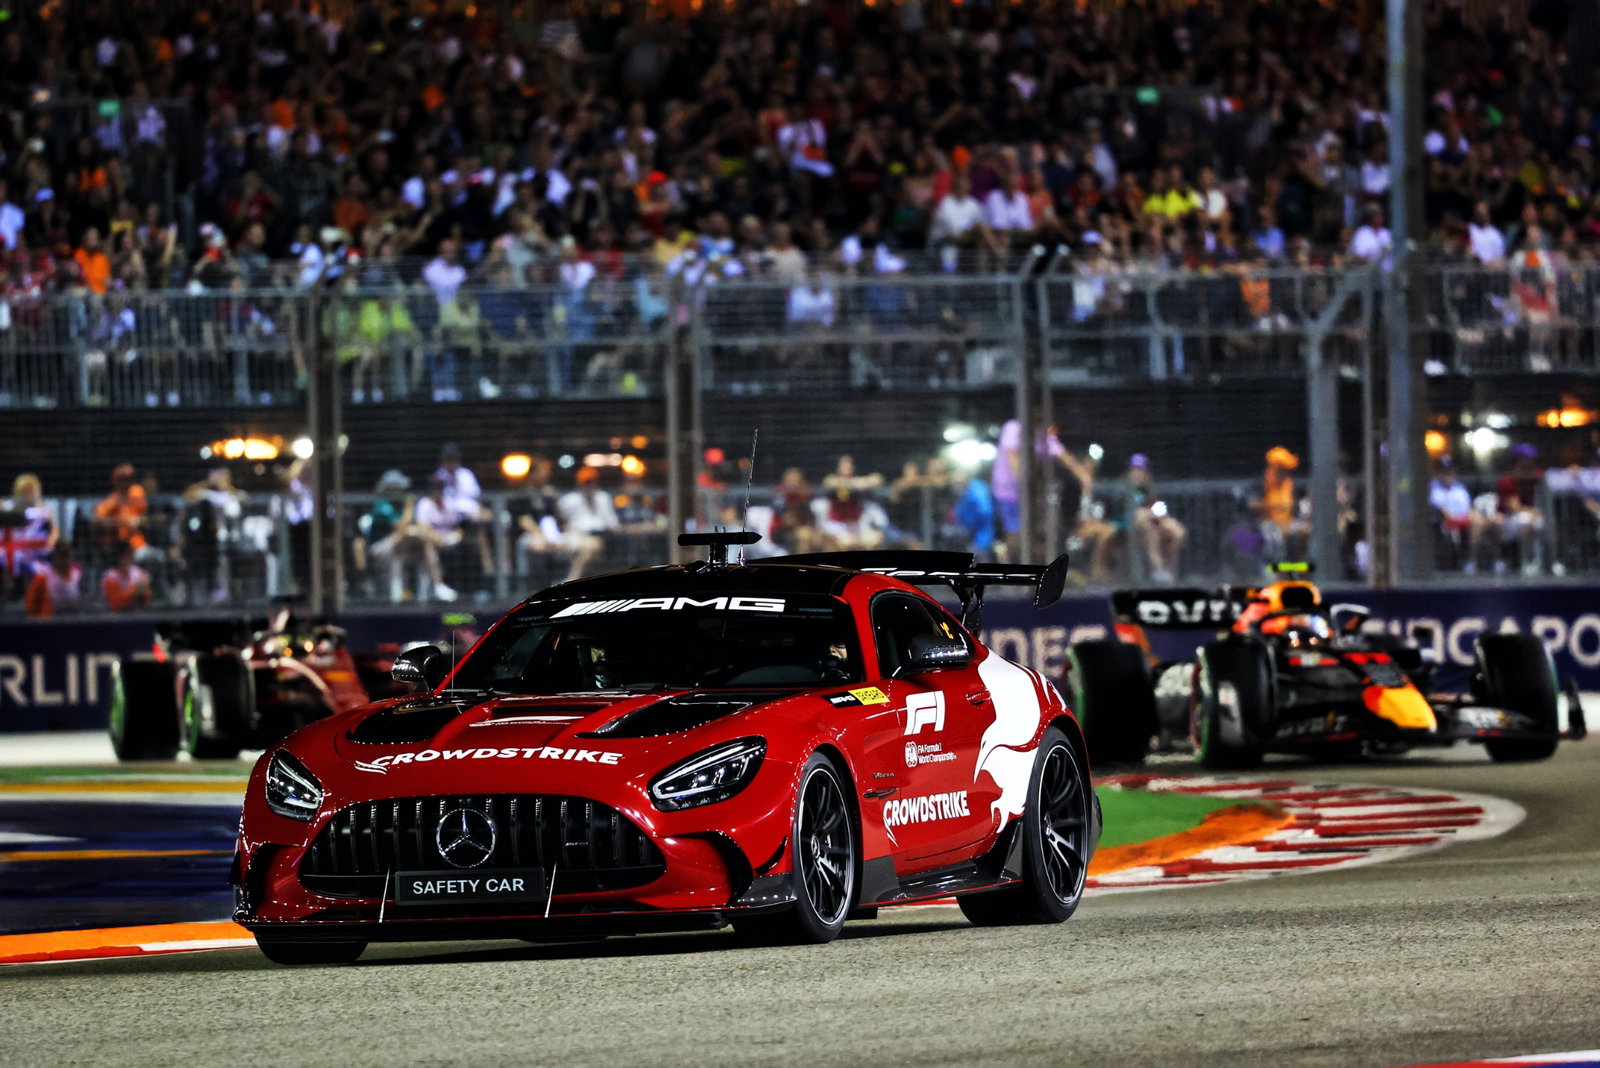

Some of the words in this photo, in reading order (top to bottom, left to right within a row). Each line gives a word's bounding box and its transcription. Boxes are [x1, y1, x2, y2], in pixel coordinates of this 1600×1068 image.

[613, 597, 786, 613] AMG
[363, 746, 624, 769] CROWDSTRIKE
[883, 790, 971, 829] CROWDSTRIKE
[412, 879, 480, 895] SAFETY
[485, 878, 525, 893] CAR
